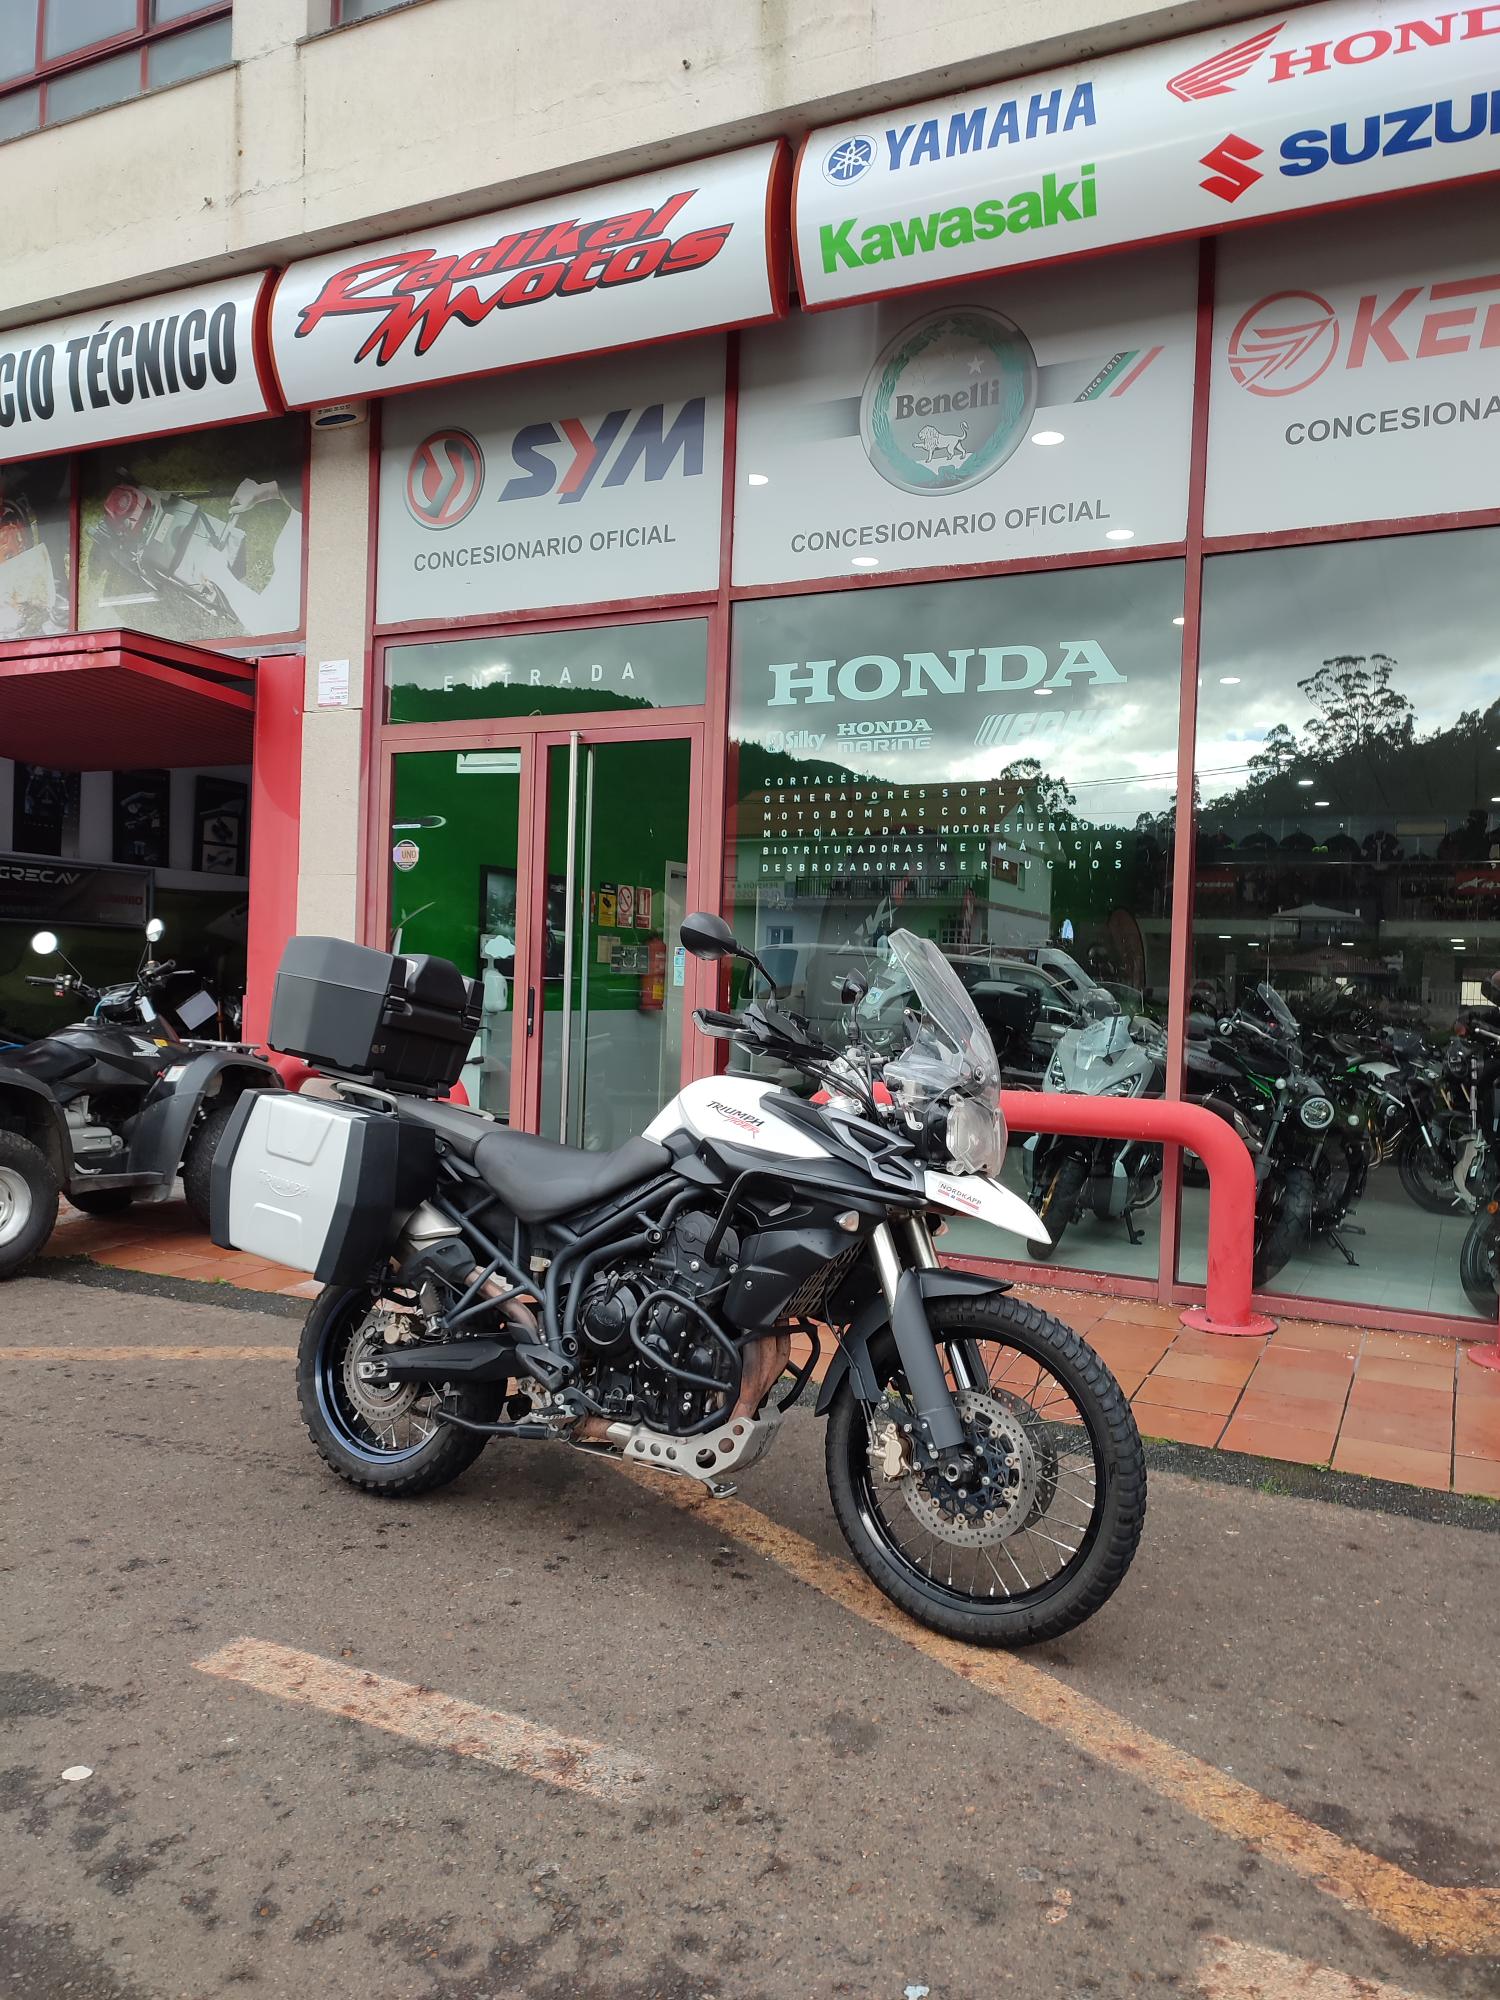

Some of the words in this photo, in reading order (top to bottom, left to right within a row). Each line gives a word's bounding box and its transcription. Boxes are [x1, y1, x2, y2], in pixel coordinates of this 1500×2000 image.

[885, 81, 1096, 171] YAMAHA
[819, 163, 1098, 274] Kawasaki
[294, 188, 700, 338] Radikal
[354, 222, 735, 367] Motos
[66, 301, 237, 413] TÉCNICO
[1080, 377, 1102, 401] since
[1103, 354, 1122, 375] 1911
[896, 379, 1000, 420] Benelli
[497, 397, 706, 504] SYM
[414, 534, 583, 572] CONCESIONARIO
[589, 524, 676, 551] OFICIAL
[791, 511, 996, 553] CONCESIONARIO
[1004, 500, 1111, 529] OFICIAL
[443, 661, 635, 693] ENTRADA
[767, 639, 1128, 706] HONDA
[786, 730, 827, 750] Silky
[836, 718, 933, 736] HONDA
[763, 807, 925, 821] MOTOBOMBAS
[764, 789, 926, 804] GENERADORES
[762, 843, 924, 856] BIOTRITURADORAS
[940, 839, 1123, 852] NEUMÁTICAS
[763, 826, 924, 839] MOTOAZADAS
[762, 861, 924, 873] DESBROZADORAS
[939, 860, 1122, 872] SERRUCHOS
[706, 1100, 765, 1126] TRIUMPH
